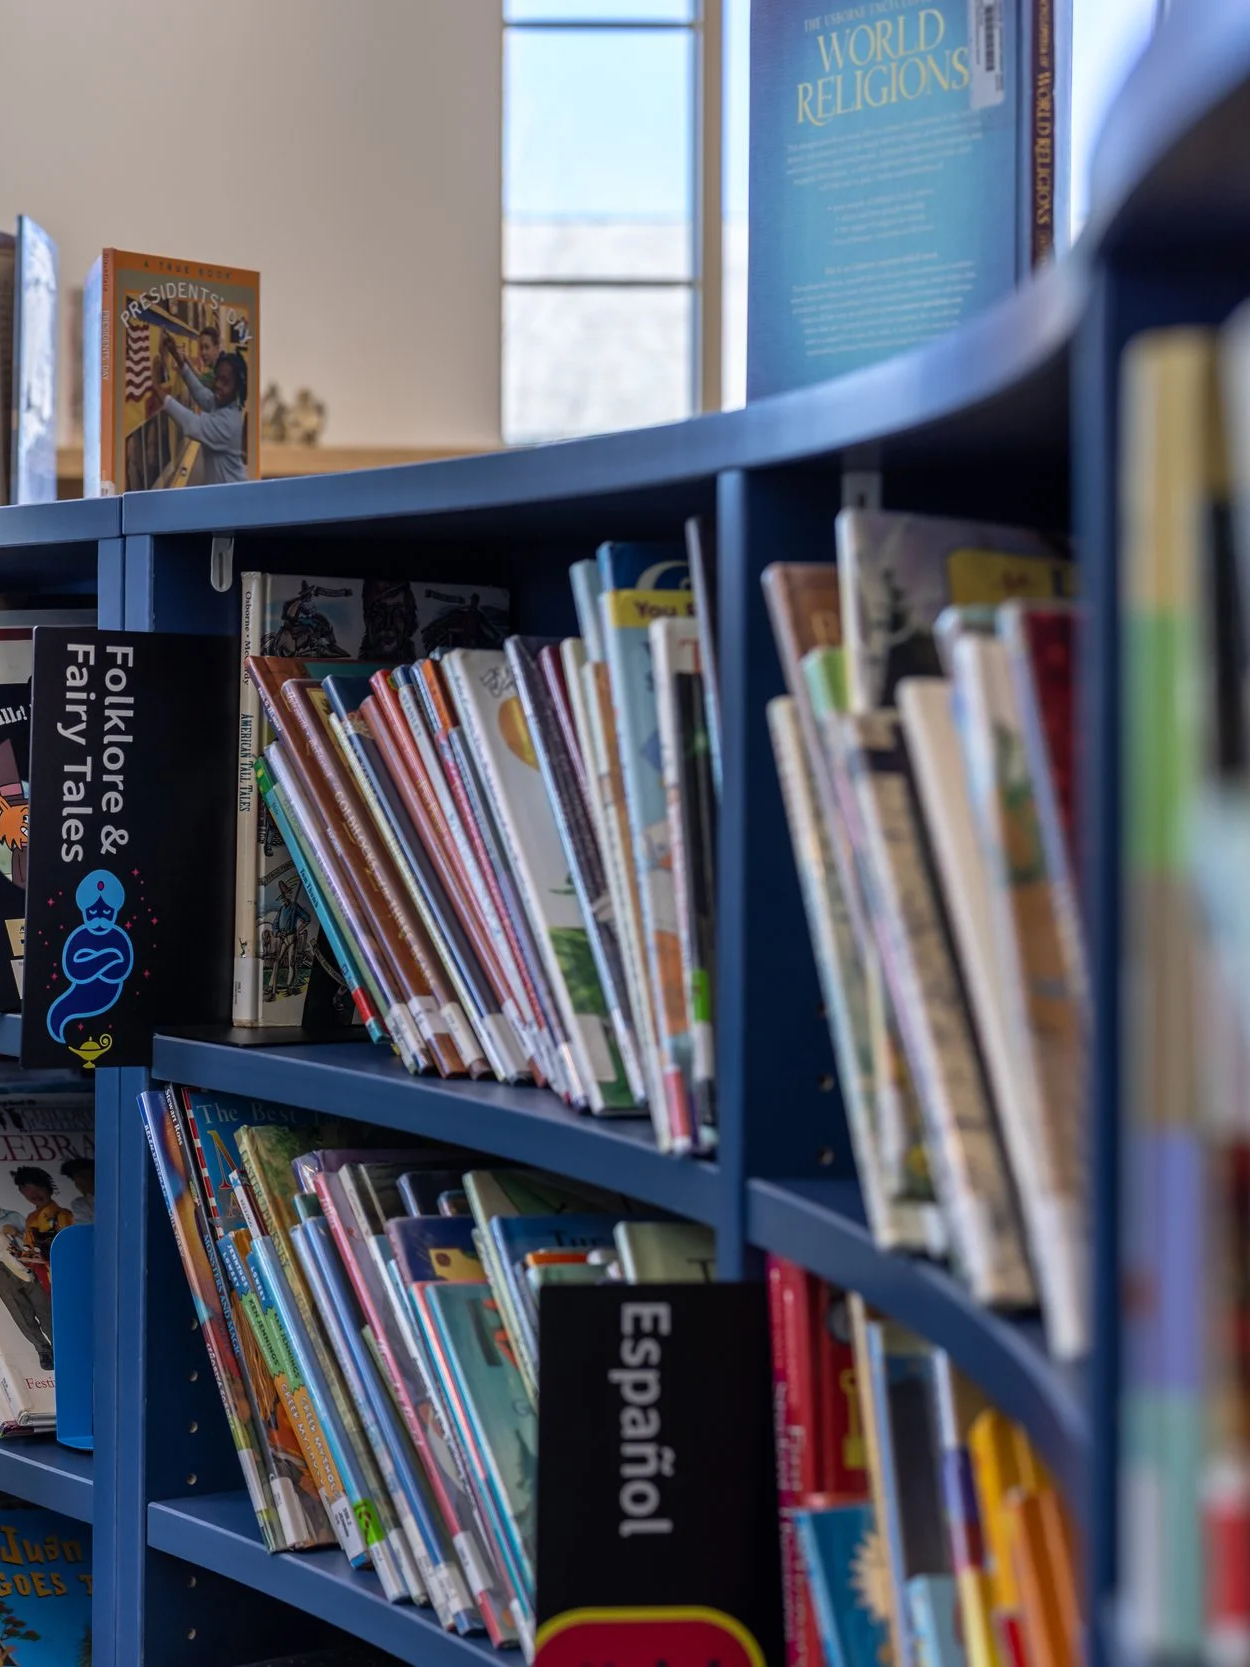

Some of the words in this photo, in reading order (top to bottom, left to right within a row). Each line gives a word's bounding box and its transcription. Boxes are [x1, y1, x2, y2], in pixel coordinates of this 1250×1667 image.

[817, 8, 946, 73] WORLD
[797, 46, 969, 127] RELIGIONS
[120, 282, 225, 328] PRESIDENTS'
[244, 591, 252, 632] Osborne
[242, 639, 252, 686] Mcrdy
[56, 643, 96, 746] Fairy
[101, 645, 135, 814] Folklore
[240, 713, 255, 758] AMERICAN
[239, 759, 254, 783] TALL
[60, 756, 94, 863] Tales
[238, 784, 254, 812] TALES
[100, 825, 130, 855] &
[165, 1088, 179, 1122] Stewart
[174, 1122, 184, 1146] Ross
[196, 1102, 240, 1125] The
[251, 1102, 297, 1124] Best
[203, 1234, 223, 1293] MONSTERS
[219, 1294, 231, 1321] AND
[227, 1320, 241, 1357] MAGIC
[255, 1315, 281, 1367] JENNINGS
[607, 1301, 677, 1539] Español
